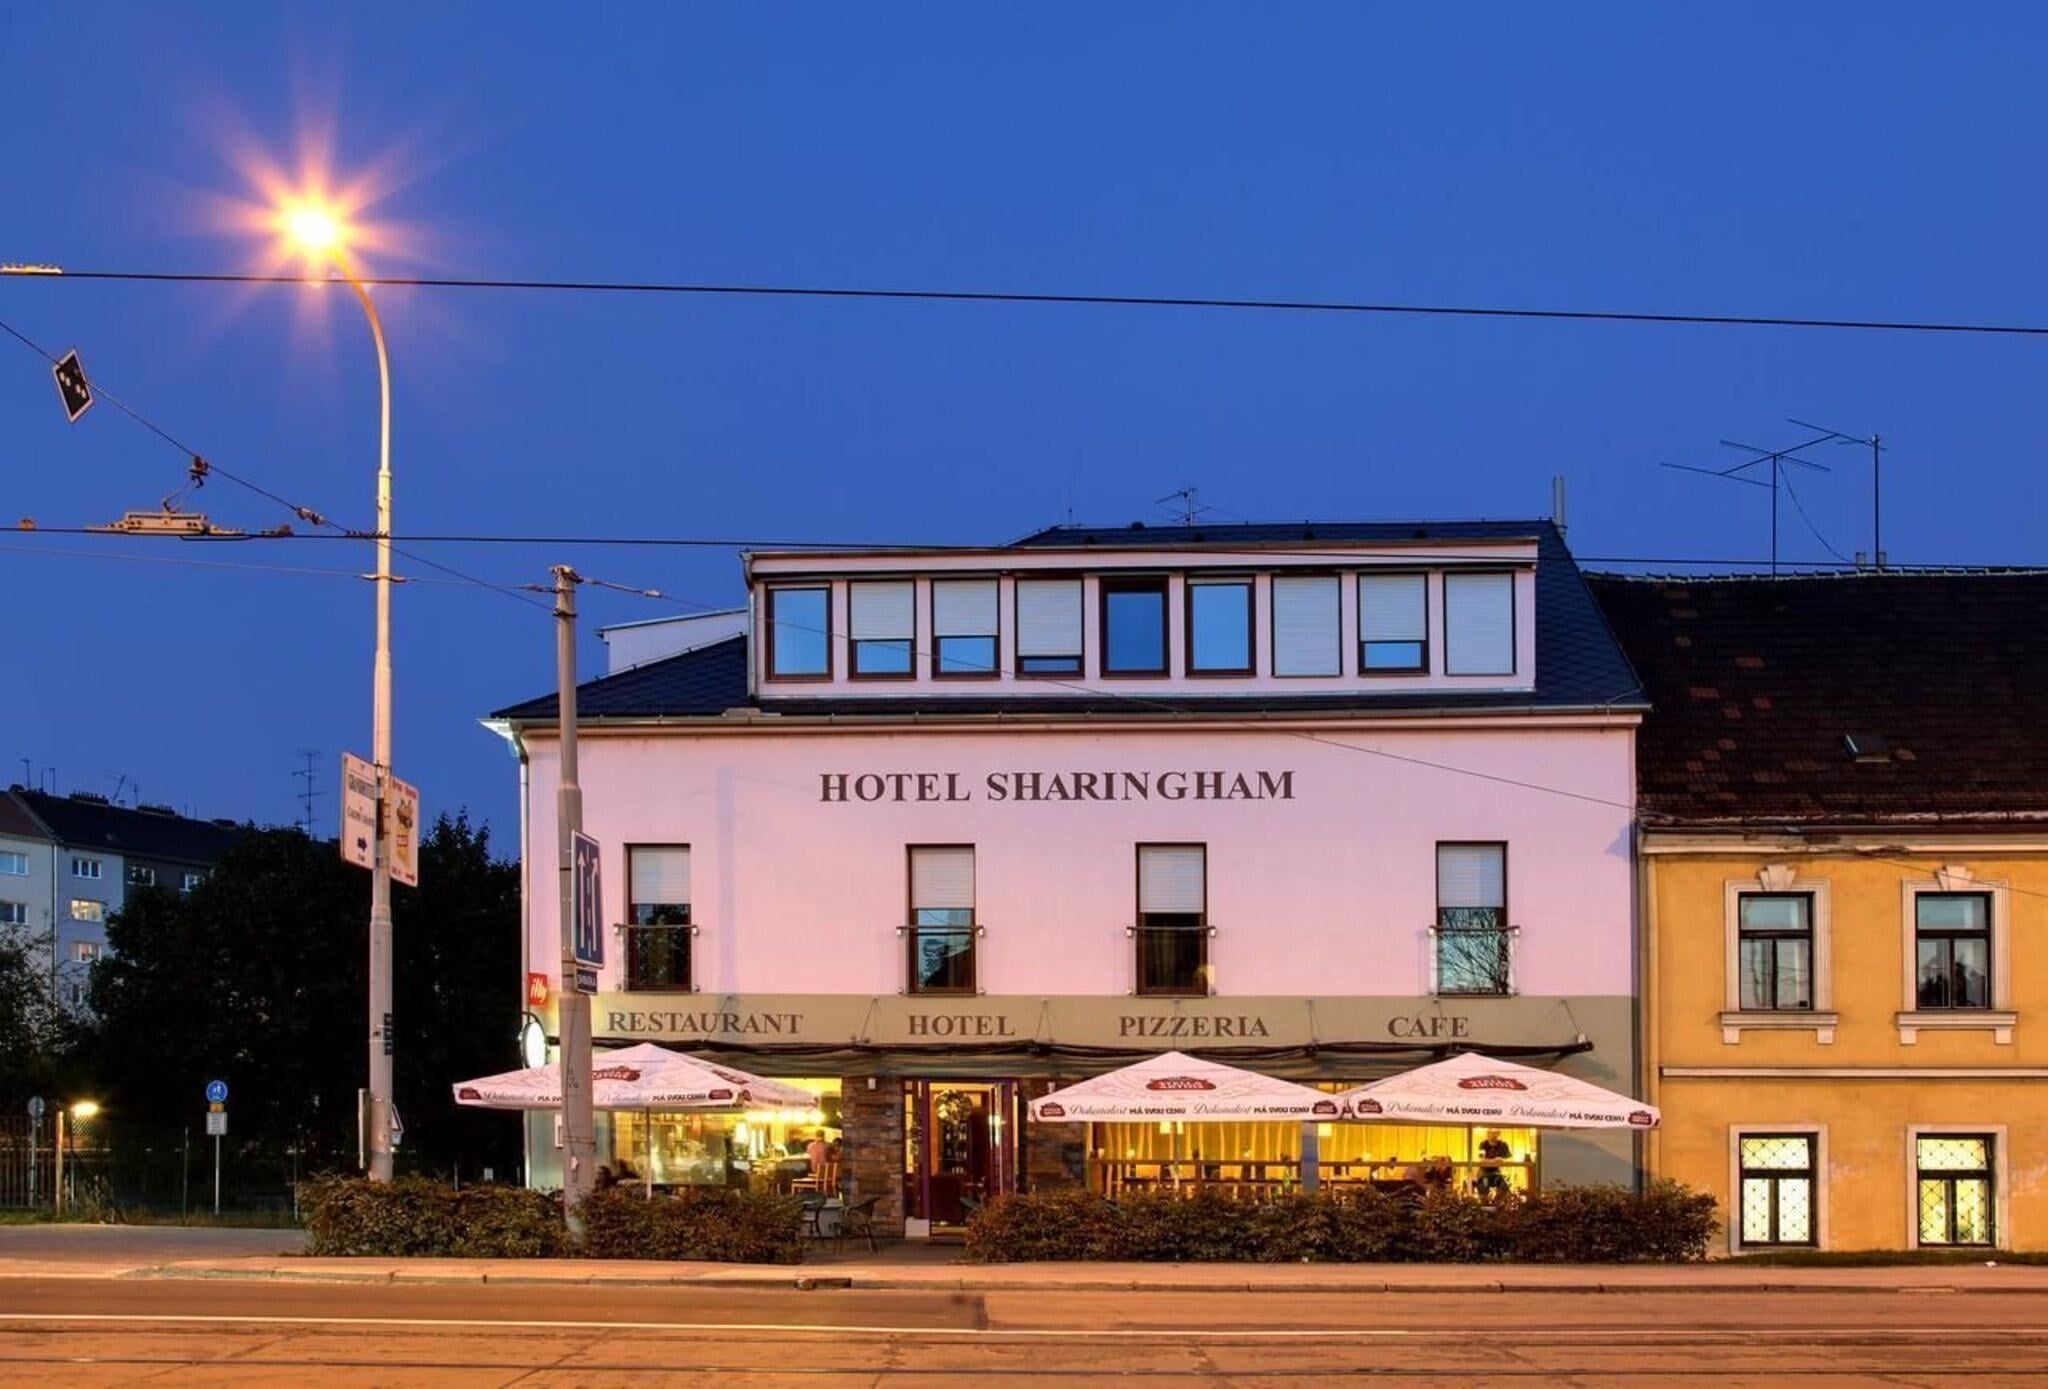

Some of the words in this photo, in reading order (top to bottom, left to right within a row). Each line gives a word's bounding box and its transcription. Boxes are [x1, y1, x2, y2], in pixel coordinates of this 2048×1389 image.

[820, 773, 971, 802] HOTEL
[987, 770, 1294, 801] SHARINGHAM
[608, 1012, 803, 1034] RESTAURANT
[909, 1015, 1014, 1036] HOTEL
[1119, 1016, 1269, 1037] PIZZERIA
[1388, 1016, 1469, 1038] CAFE
